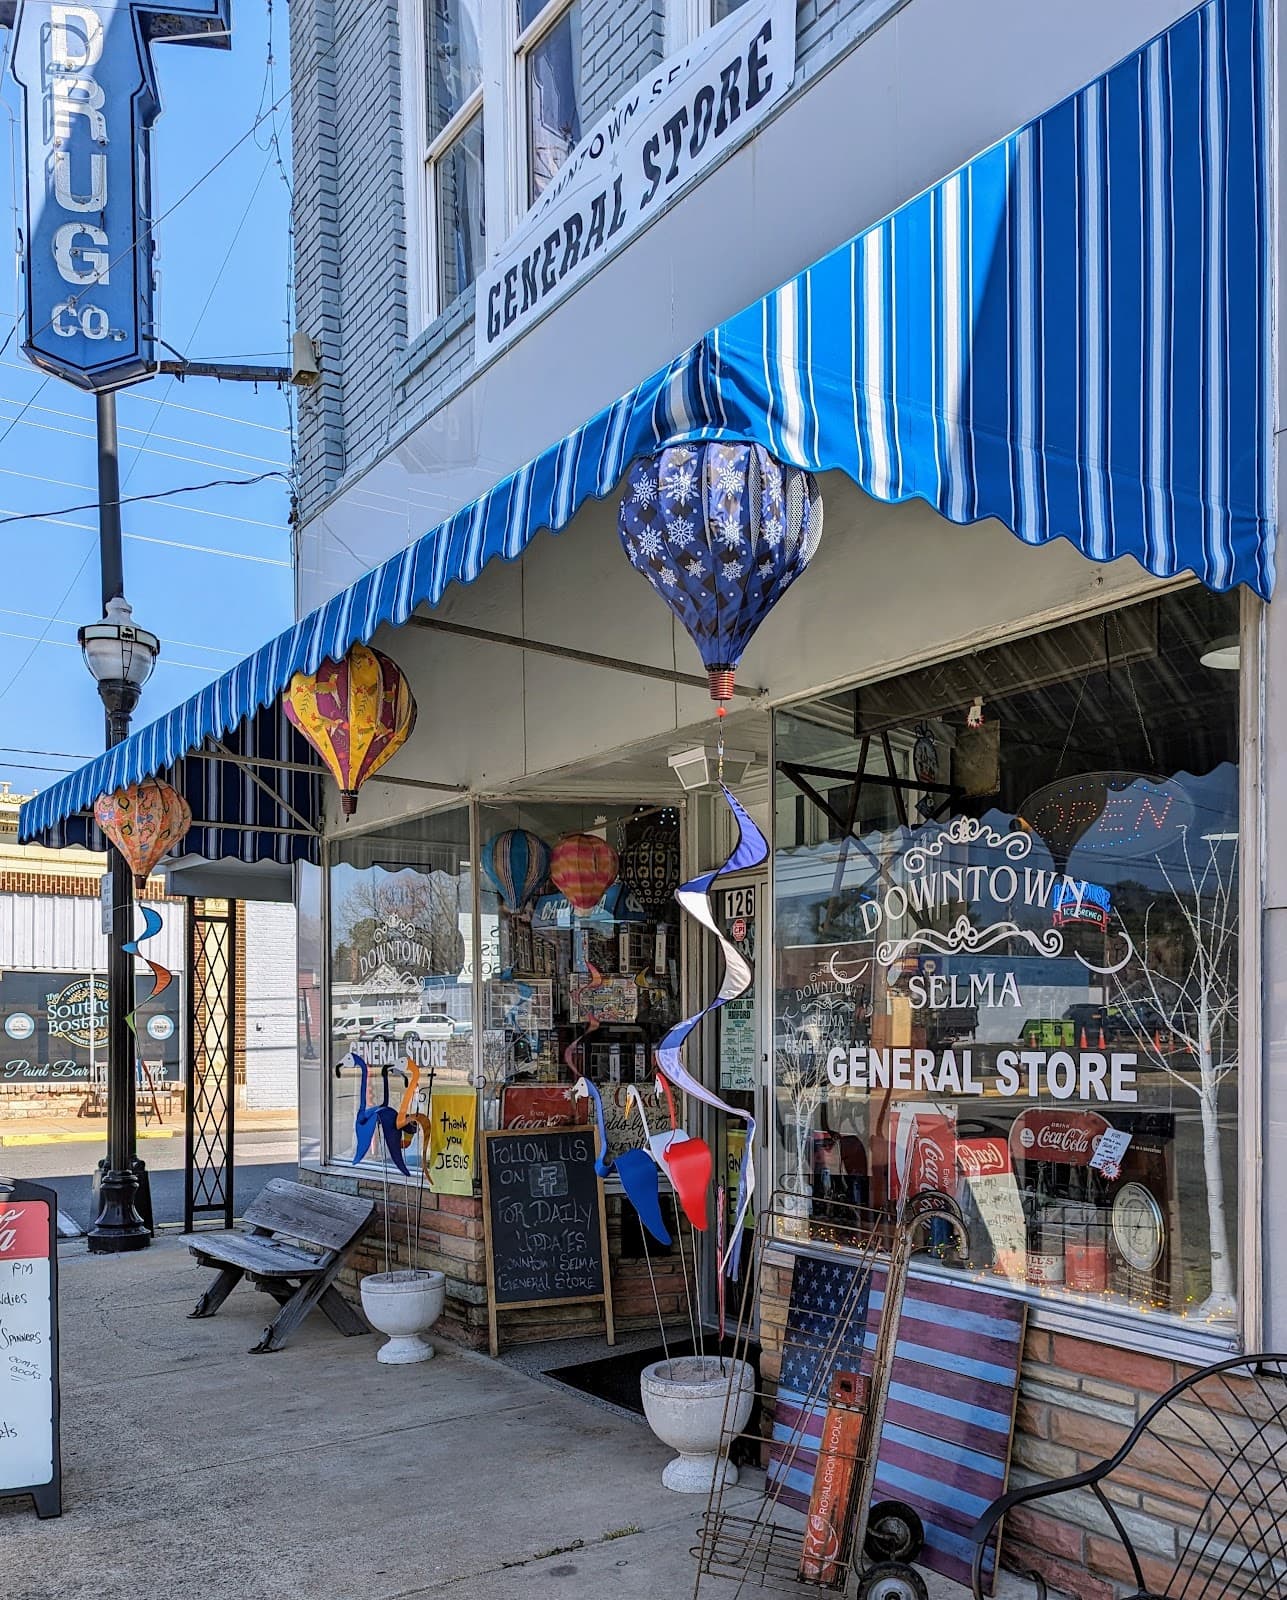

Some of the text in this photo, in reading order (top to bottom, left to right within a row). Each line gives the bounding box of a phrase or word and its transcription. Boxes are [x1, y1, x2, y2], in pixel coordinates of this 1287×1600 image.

[50, 3, 111, 286] DRUG
[486, 18, 775, 344] GENERAL STORE
[1033, 796, 1172, 834] OPEN
[727, 889, 754, 918] 126
[859, 865, 1090, 936] DOWNTOWN
[359, 939, 433, 978] DOWNTOWN
[908, 972, 1023, 1010] SELMA
[3, 1059, 90, 1079] Paint Bar
[405, 1039, 448, 1067] STORE
[826, 1046, 1139, 1103] GENERAL STORE
[446, 1135, 462, 1151] you
[491, 1138, 588, 1165] FOLLOW US
[1037, 1125, 1090, 1153] Coca-Cola
[435, 1152, 470, 1170] JESUS
[500, 1168, 526, 1186] ON
[497, 1195, 593, 1233] FOR DAILY
[12, 1262, 34, 1278] PM
[818, 1416, 843, 1515] ROYAL CROWN COLA
